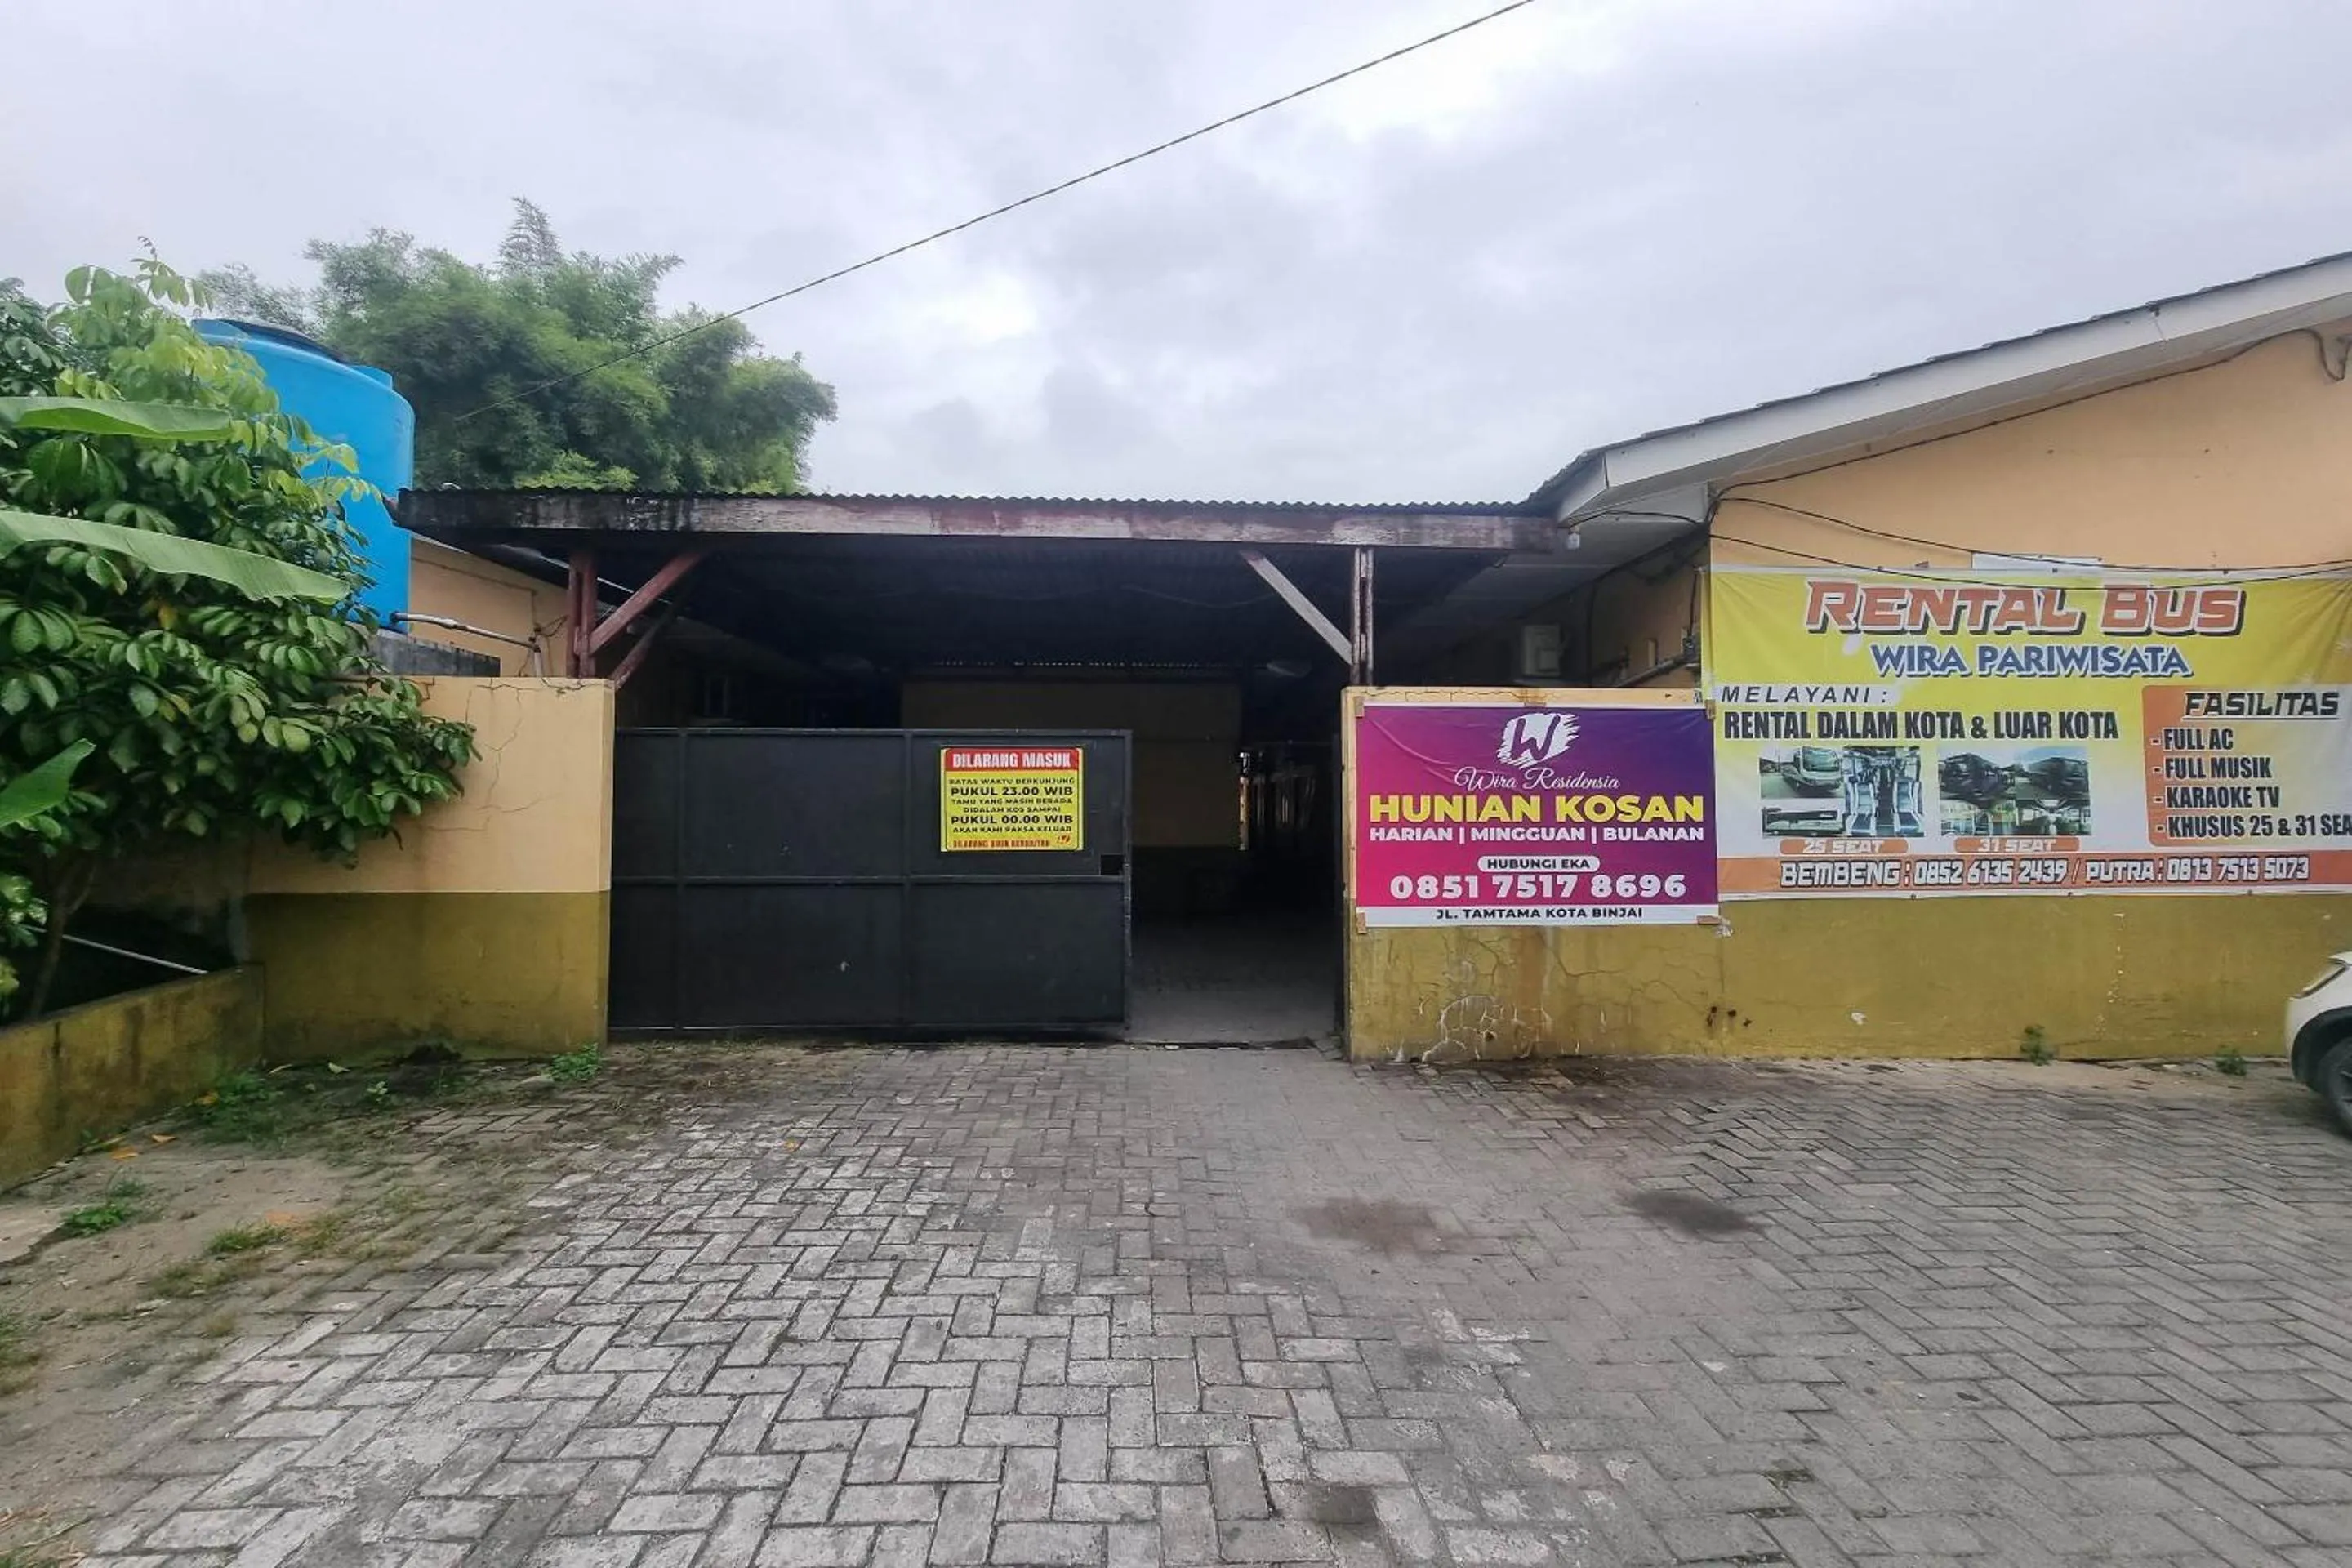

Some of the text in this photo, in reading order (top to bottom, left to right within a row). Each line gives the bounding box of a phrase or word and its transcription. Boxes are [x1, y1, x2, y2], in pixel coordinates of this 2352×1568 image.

[1804, 578, 2246, 637] RENTAL BUS
[1871, 644, 2195, 678] WIRA PARIWISATA
[2185, 692, 2341, 716] FASILITAS
[1724, 710, 2120, 739] RENTAL DALAM KOTA & LUAR KOTA
[2163, 728, 2205, 751] FULL
[2208, 728, 2234, 751] AC
[952, 753, 1071, 768] DILARANG MASUK
[2165, 757, 2207, 779] FULL
[2210, 756, 2273, 778] MUSIK
[1454, 766, 1621, 791] Wira Residensia
[951, 786, 1073, 796] PUKUL 23.00 WIB
[2166, 786, 2253, 808] KARAOKE
[2256, 786, 2281, 808] TV
[951, 815, 1073, 825] PUKUL 00.00 WIB
[1369, 795, 1704, 823] HUNIAN KOSAN
[1370, 827, 1454, 842] HARIAN
[1471, 826, 1586, 842] MINGGUAN
[1602, 826, 1704, 841] BULANAN
[2168, 816, 2245, 838] KHUSUS
[2249, 815, 2274, 837] 25
[2278, 817, 2292, 836] &
[2295, 814, 2317, 836] 31
[1802, 840, 1884, 853] 25 SEAT
[1977, 838, 2056, 853] 31 SEAT
[1486, 858, 1591, 870] HUBUNGI EKA
[1913, 860, 1964, 885] 0852
[1967, 858, 2014, 885] 6135
[2017, 858, 2069, 885] 2439
[2166, 856, 2212, 882] 0813
[2217, 856, 2260, 882] 7513
[2263, 855, 2310, 881] 5073
[1390, 874, 1687, 900] 0851 7517 8696
[1437, 907, 1642, 920] JL. TAMTAMA KOTA BINJAI
